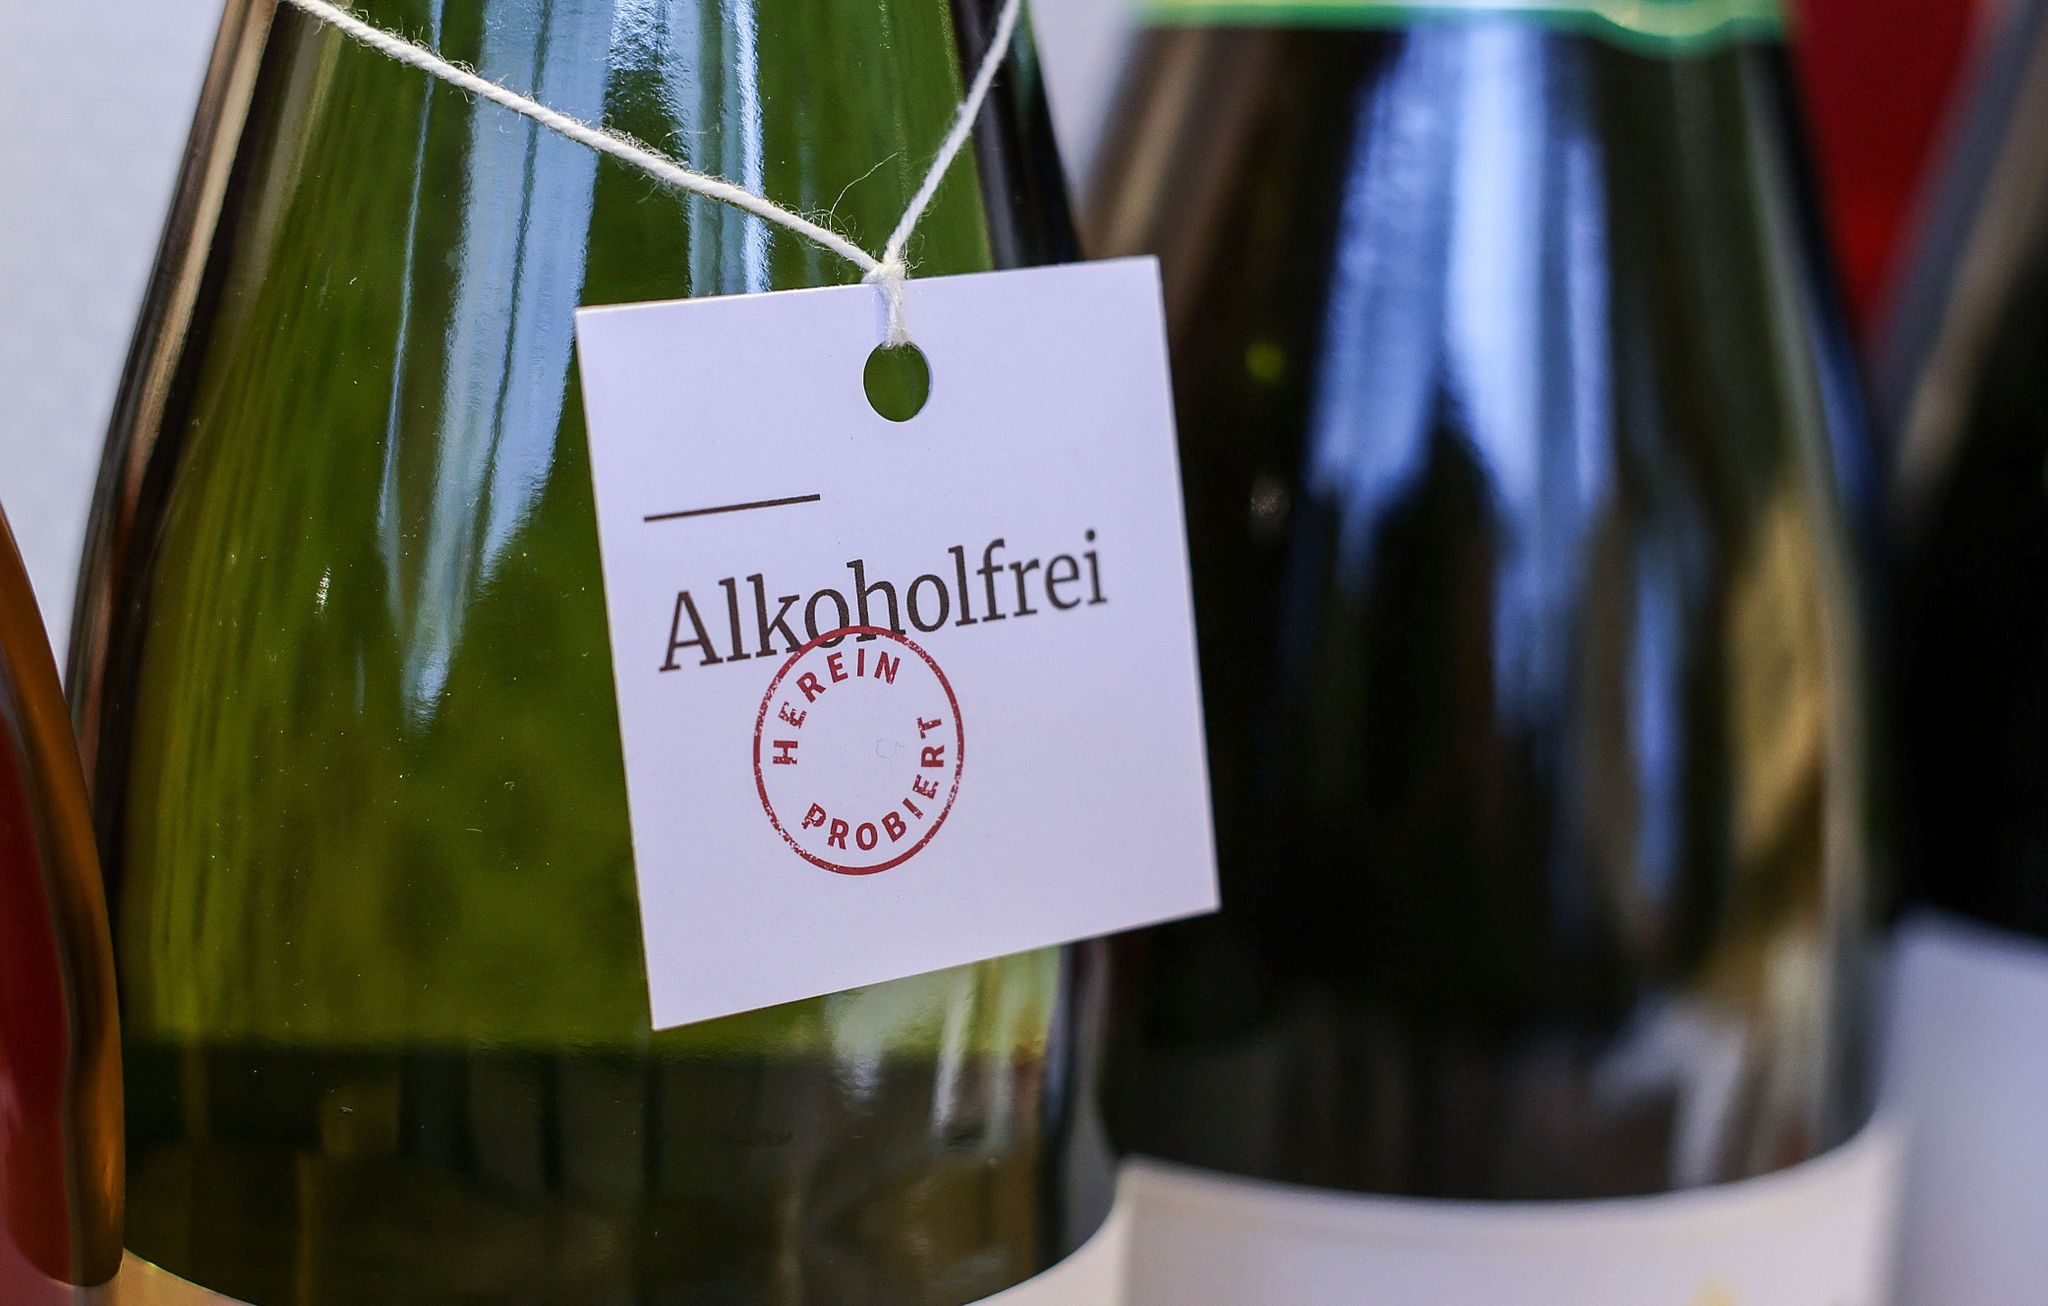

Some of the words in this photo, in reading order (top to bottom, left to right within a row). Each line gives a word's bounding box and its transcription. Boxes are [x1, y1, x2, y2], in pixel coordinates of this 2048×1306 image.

[658, 528, 1108, 674] Alkoholfrei
[772, 647, 901, 765] HEREIN
[801, 716, 945, 852] PROBIERT
